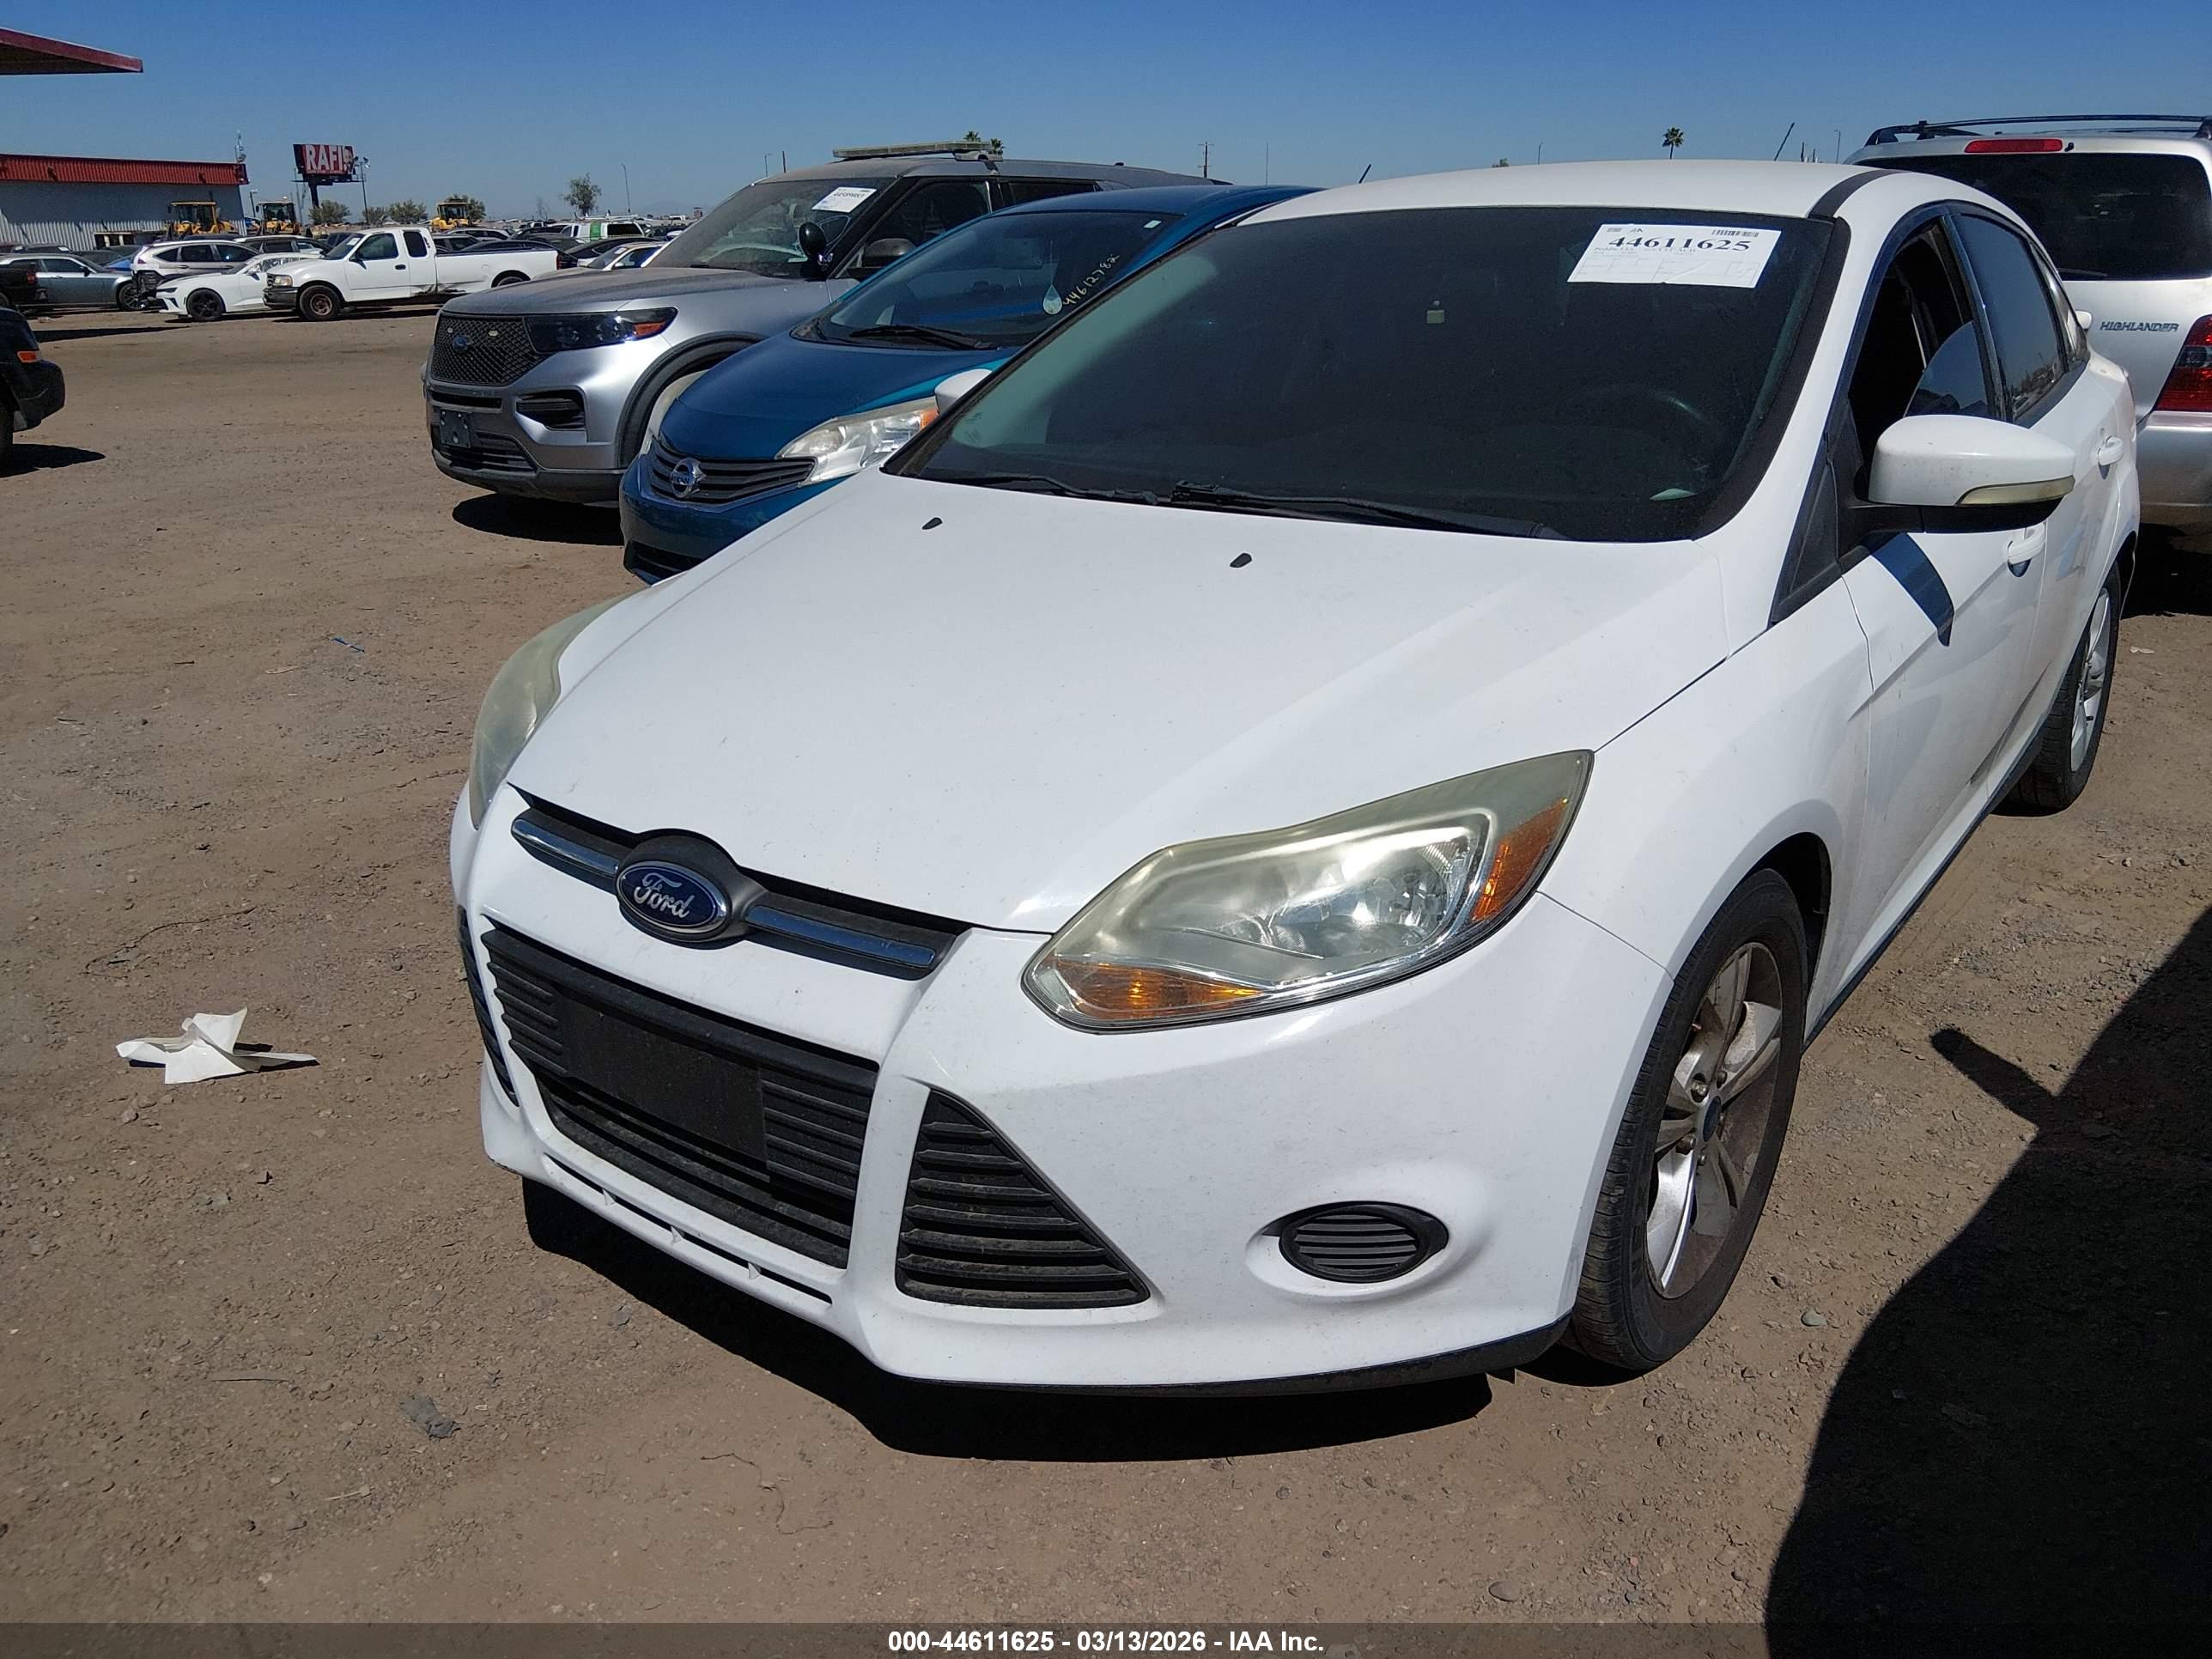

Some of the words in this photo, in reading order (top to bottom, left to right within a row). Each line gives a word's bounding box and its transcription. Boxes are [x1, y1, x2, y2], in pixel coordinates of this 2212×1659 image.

[1607, 235, 1753, 252] 44611625
[1062, 253, 1120, 305] 44612782
[2100, 321, 2179, 332] HIGHLANDER
[633, 872, 695, 919] Ford
